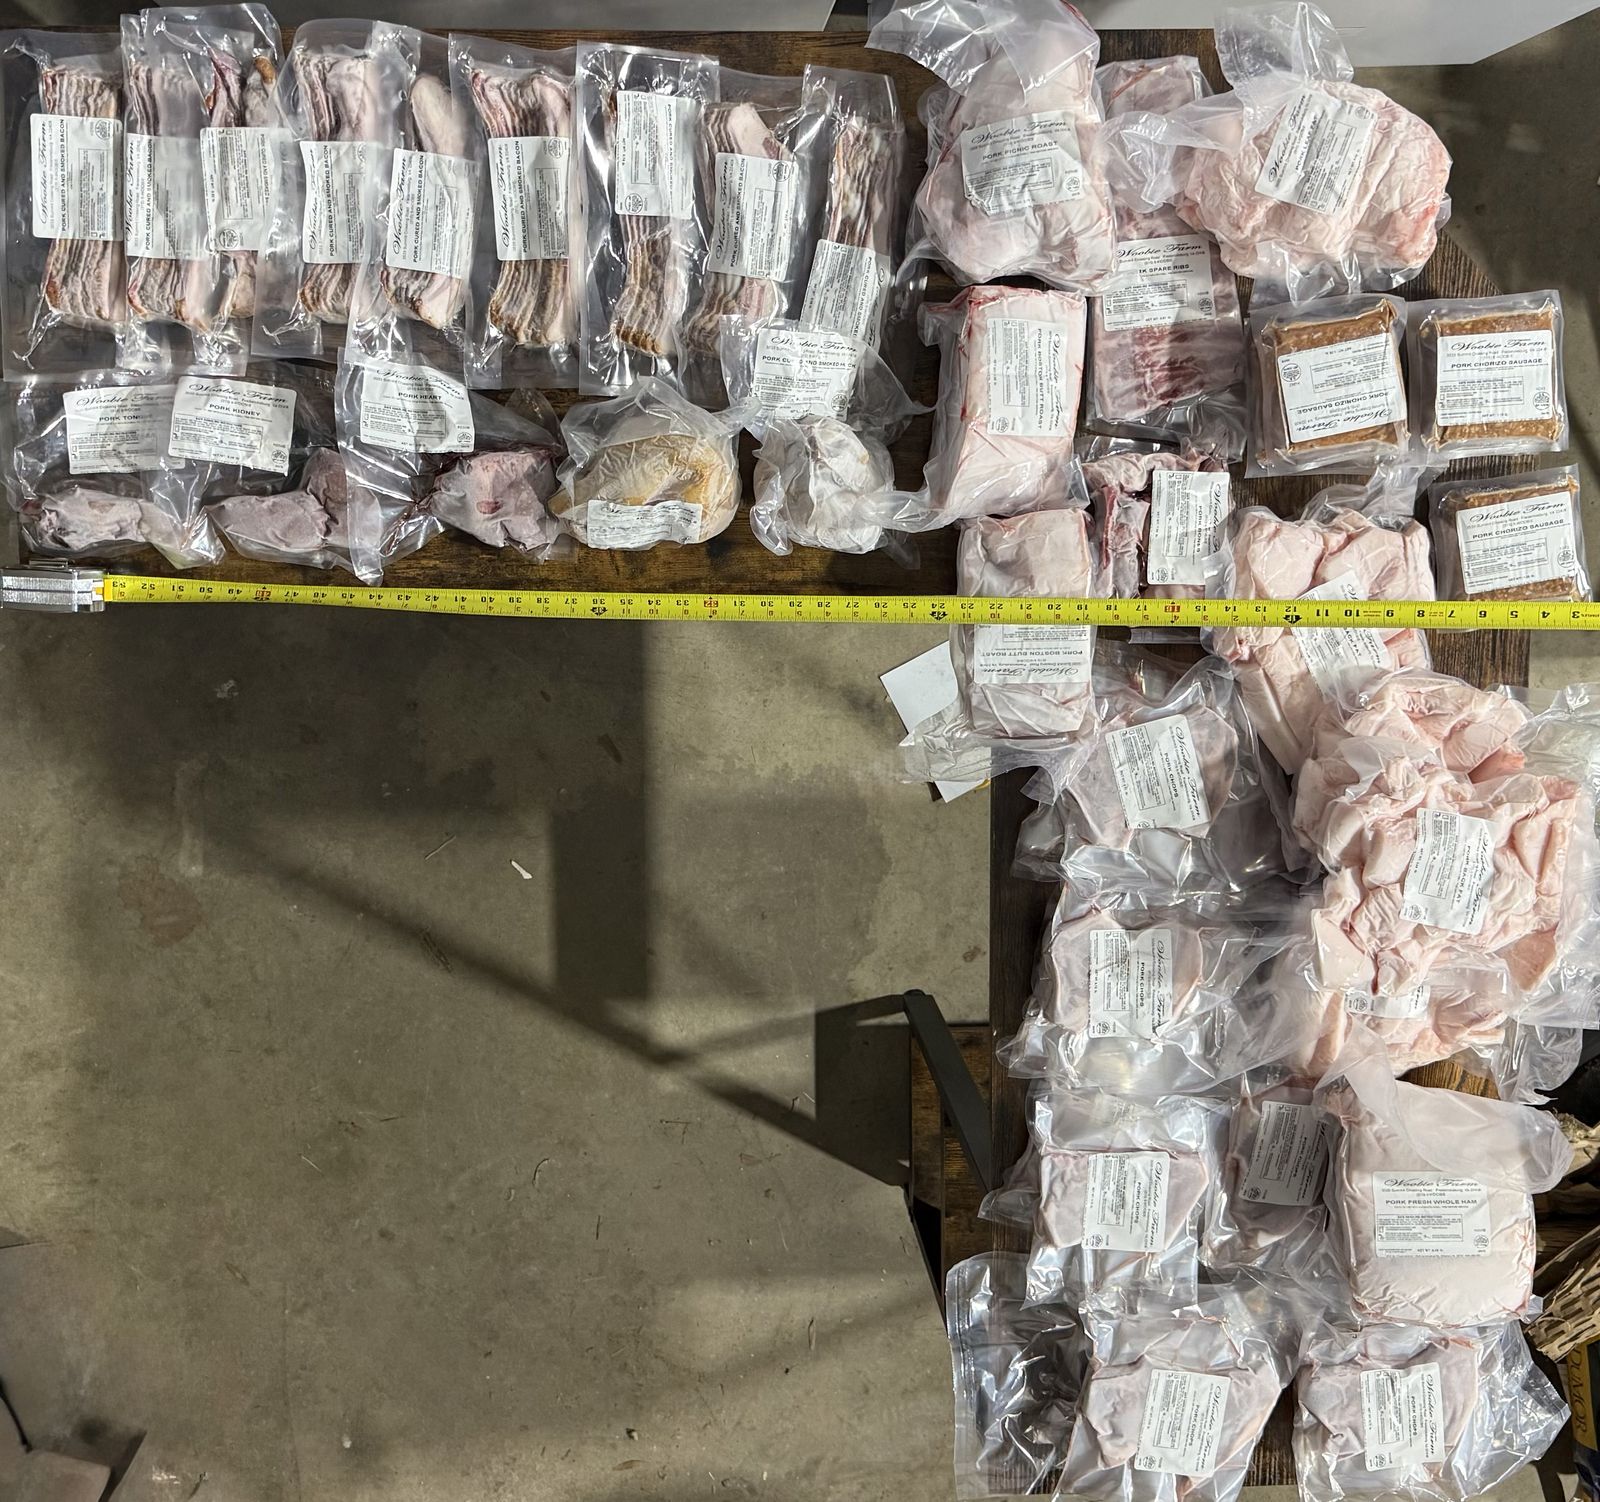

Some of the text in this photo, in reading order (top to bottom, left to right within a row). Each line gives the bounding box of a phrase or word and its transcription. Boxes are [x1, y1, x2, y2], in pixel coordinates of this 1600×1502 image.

[982, 140, 1058, 160] PORK PICNIC ROAST
[516, 165, 525, 194] SMOKED
[731, 225, 739, 249] CURED
[1503, 339, 1545, 348] Farm
[398, 391, 442, 401] PORK HEART
[1297, 392, 1389, 415] PORK CHORIZO SAUSAGE
[209, 403, 261, 417] PORK KIDNEY
[1522, 502, 1565, 515] Farm
[1472, 519, 1564, 539] PORK CHORIZO SAUSAGE
[141, 583, 156, 591] 52
[199, 586, 213, 594] 50
[283, 590, 299, 598] 47
[425, 594, 440, 602] 42
[509, 596, 522, 604] 39
[620, 598, 634, 606] 35
[1136, 604, 1148, 612] 17
[1315, 609, 1330, 617] 11
[1344, 609, 1360, 617] 10
[1386, 609, 1395, 617] 9
[1417, 610, 1426, 618] 8
[1447, 610, 1456, 618] 7
[1478, 610, 1487, 618] 6
[1510, 610, 1518, 618] 5
[1164, 752, 1179, 798] PORK CHOPS
[1459, 866, 1468, 887] BACK
[1456, 888, 1464, 903] FAT
[1189, 1423, 1197, 1446] CHOPS
